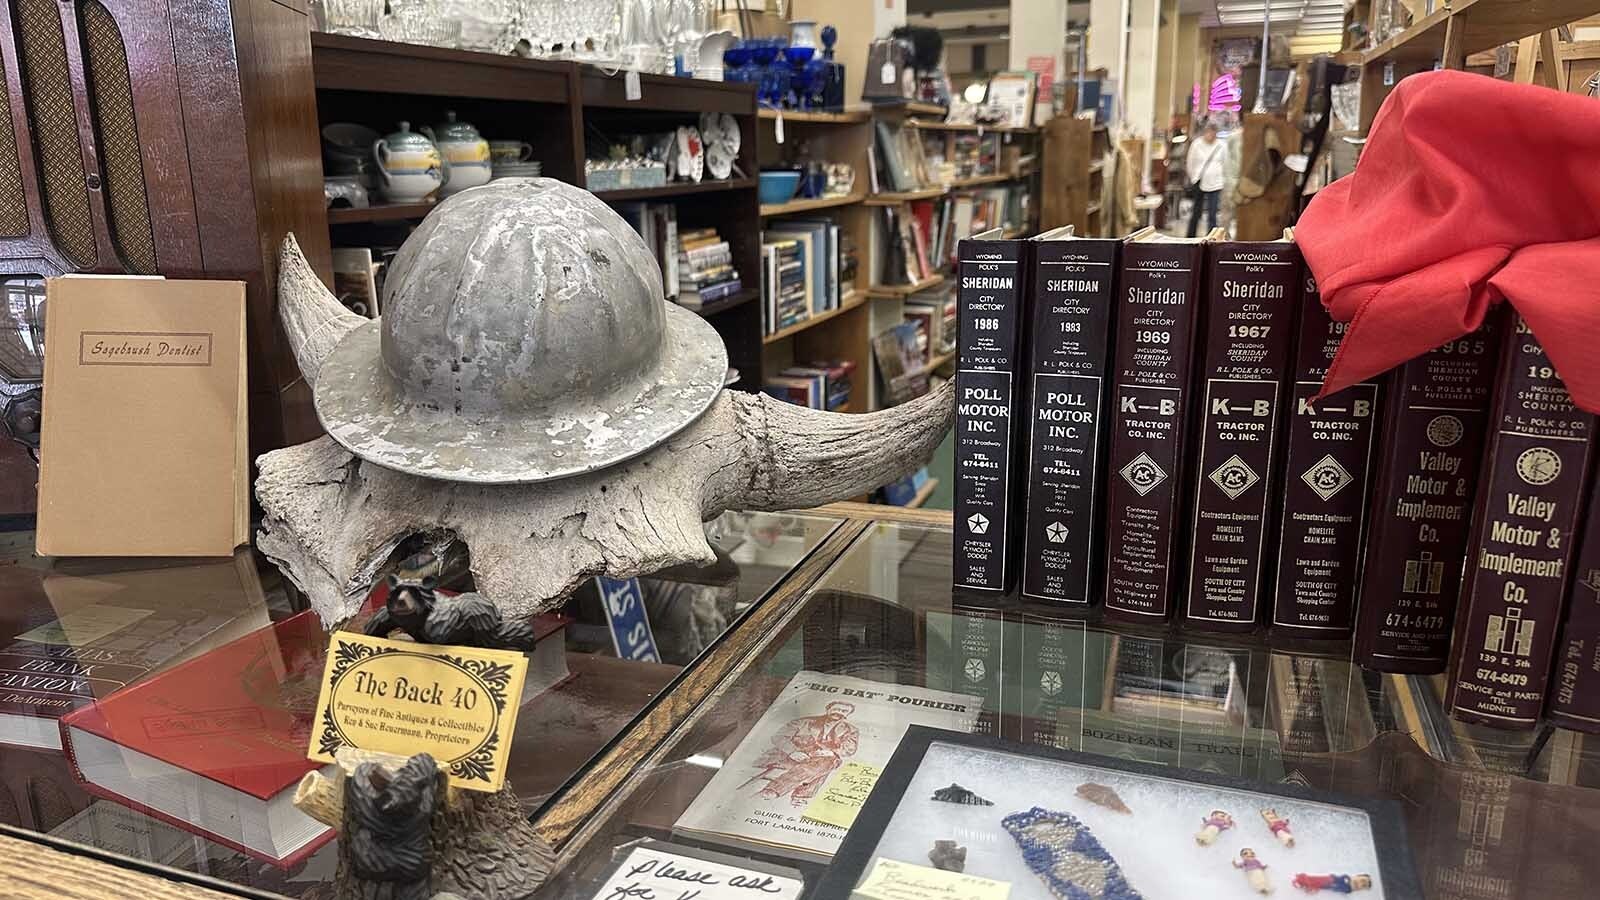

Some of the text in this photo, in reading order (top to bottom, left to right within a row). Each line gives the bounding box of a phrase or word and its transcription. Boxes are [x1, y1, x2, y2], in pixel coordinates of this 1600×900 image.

[962, 277, 1013, 289] SHERIDAN
[1047, 280, 1099, 292] SHERIDAN
[1223, 280, 1284, 298] Sheridan
[1128, 287, 1185, 304] Sheridan
[974, 318, 999, 330] 1986
[1060, 322, 1081, 333] 1983
[1134, 318, 1175, 326] DIRECTORY
[1328, 322, 1351, 334] 196
[1135, 331, 1170, 344] 1969
[1228, 325, 1271, 338] 1967
[92, 341, 202, 358] Sagebrush Dentist
[1523, 344, 1543, 355] City
[965, 388, 1001, 400] POLL
[1047, 393, 1086, 406] POLL
[1518, 391, 1572, 403] SHERIDA
[959, 404, 1008, 417] MOTOR
[1522, 401, 1574, 412] COUNTY
[1039, 409, 1092, 423] MOTOR
[968, 420, 996, 432] INC.
[1125, 420, 1171, 430] TRACTOR
[1217, 422, 1265, 431] TRACTOR
[1310, 422, 1359, 430] TRACTOR
[1530, 419, 1554, 427] POLK
[1049, 426, 1078, 439] INC.
[1219, 432, 1259, 441] CO. INC.
[1313, 432, 1353, 441] CO. INC.
[1516, 426, 1574, 436] PUBLISHERS
[1056, 446, 1083, 454] Broadway
[963, 460, 999, 469] 674-6411
[1420, 451, 1461, 475] Valley
[1043, 467, 1080, 476] 674-6411
[1406, 475, 1465, 496] Motor &
[1507, 493, 1556, 520] Valley
[1201, 511, 1231, 520] Contractors
[1419, 524, 1439, 542] Co.
[1492, 521, 1561, 549] Motor &
[963, 546, 992, 554] PLYMOUTH
[1043, 549, 1070, 557] CHRYSLER
[1041, 555, 1071, 564] PLYMOUTH
[1205, 555, 1218, 563] Lawn
[1480, 548, 1563, 578] Implement
[1045, 562, 1066, 570] DODGE
[1113, 578, 1133, 586] SOUTH
[1324, 582, 1337, 590] CITY
[1044, 587, 1065, 595] SERVICE
[1504, 581, 1528, 604] Co.
[1386, 613, 1444, 629] 674-6479
[1480, 653, 1531, 668] 139 E. 5th
[20, 659, 104, 676] FRANK
[1476, 668, 1528, 686] 674-6479
[354, 670, 477, 711] The Back 40
[1458, 681, 1493, 695] SERVICE
[1496, 689, 1511, 698] and
[887, 694, 967, 712] POURIER
[1477, 702, 1517, 715] MIDNITE
[337, 701, 485, 733] Purveyors of Fine Antiques & Collectibles
[365, 718, 378, 730] Sue
[424, 729, 470, 745] Proprietors
[1082, 728, 1174, 748] BOZEMAN
[754, 809, 784, 819] GUIDE
[744, 817, 770, 826] FORT
[772, 823, 814, 834] LARAMIE
[625, 859, 781, 893] Please ask
